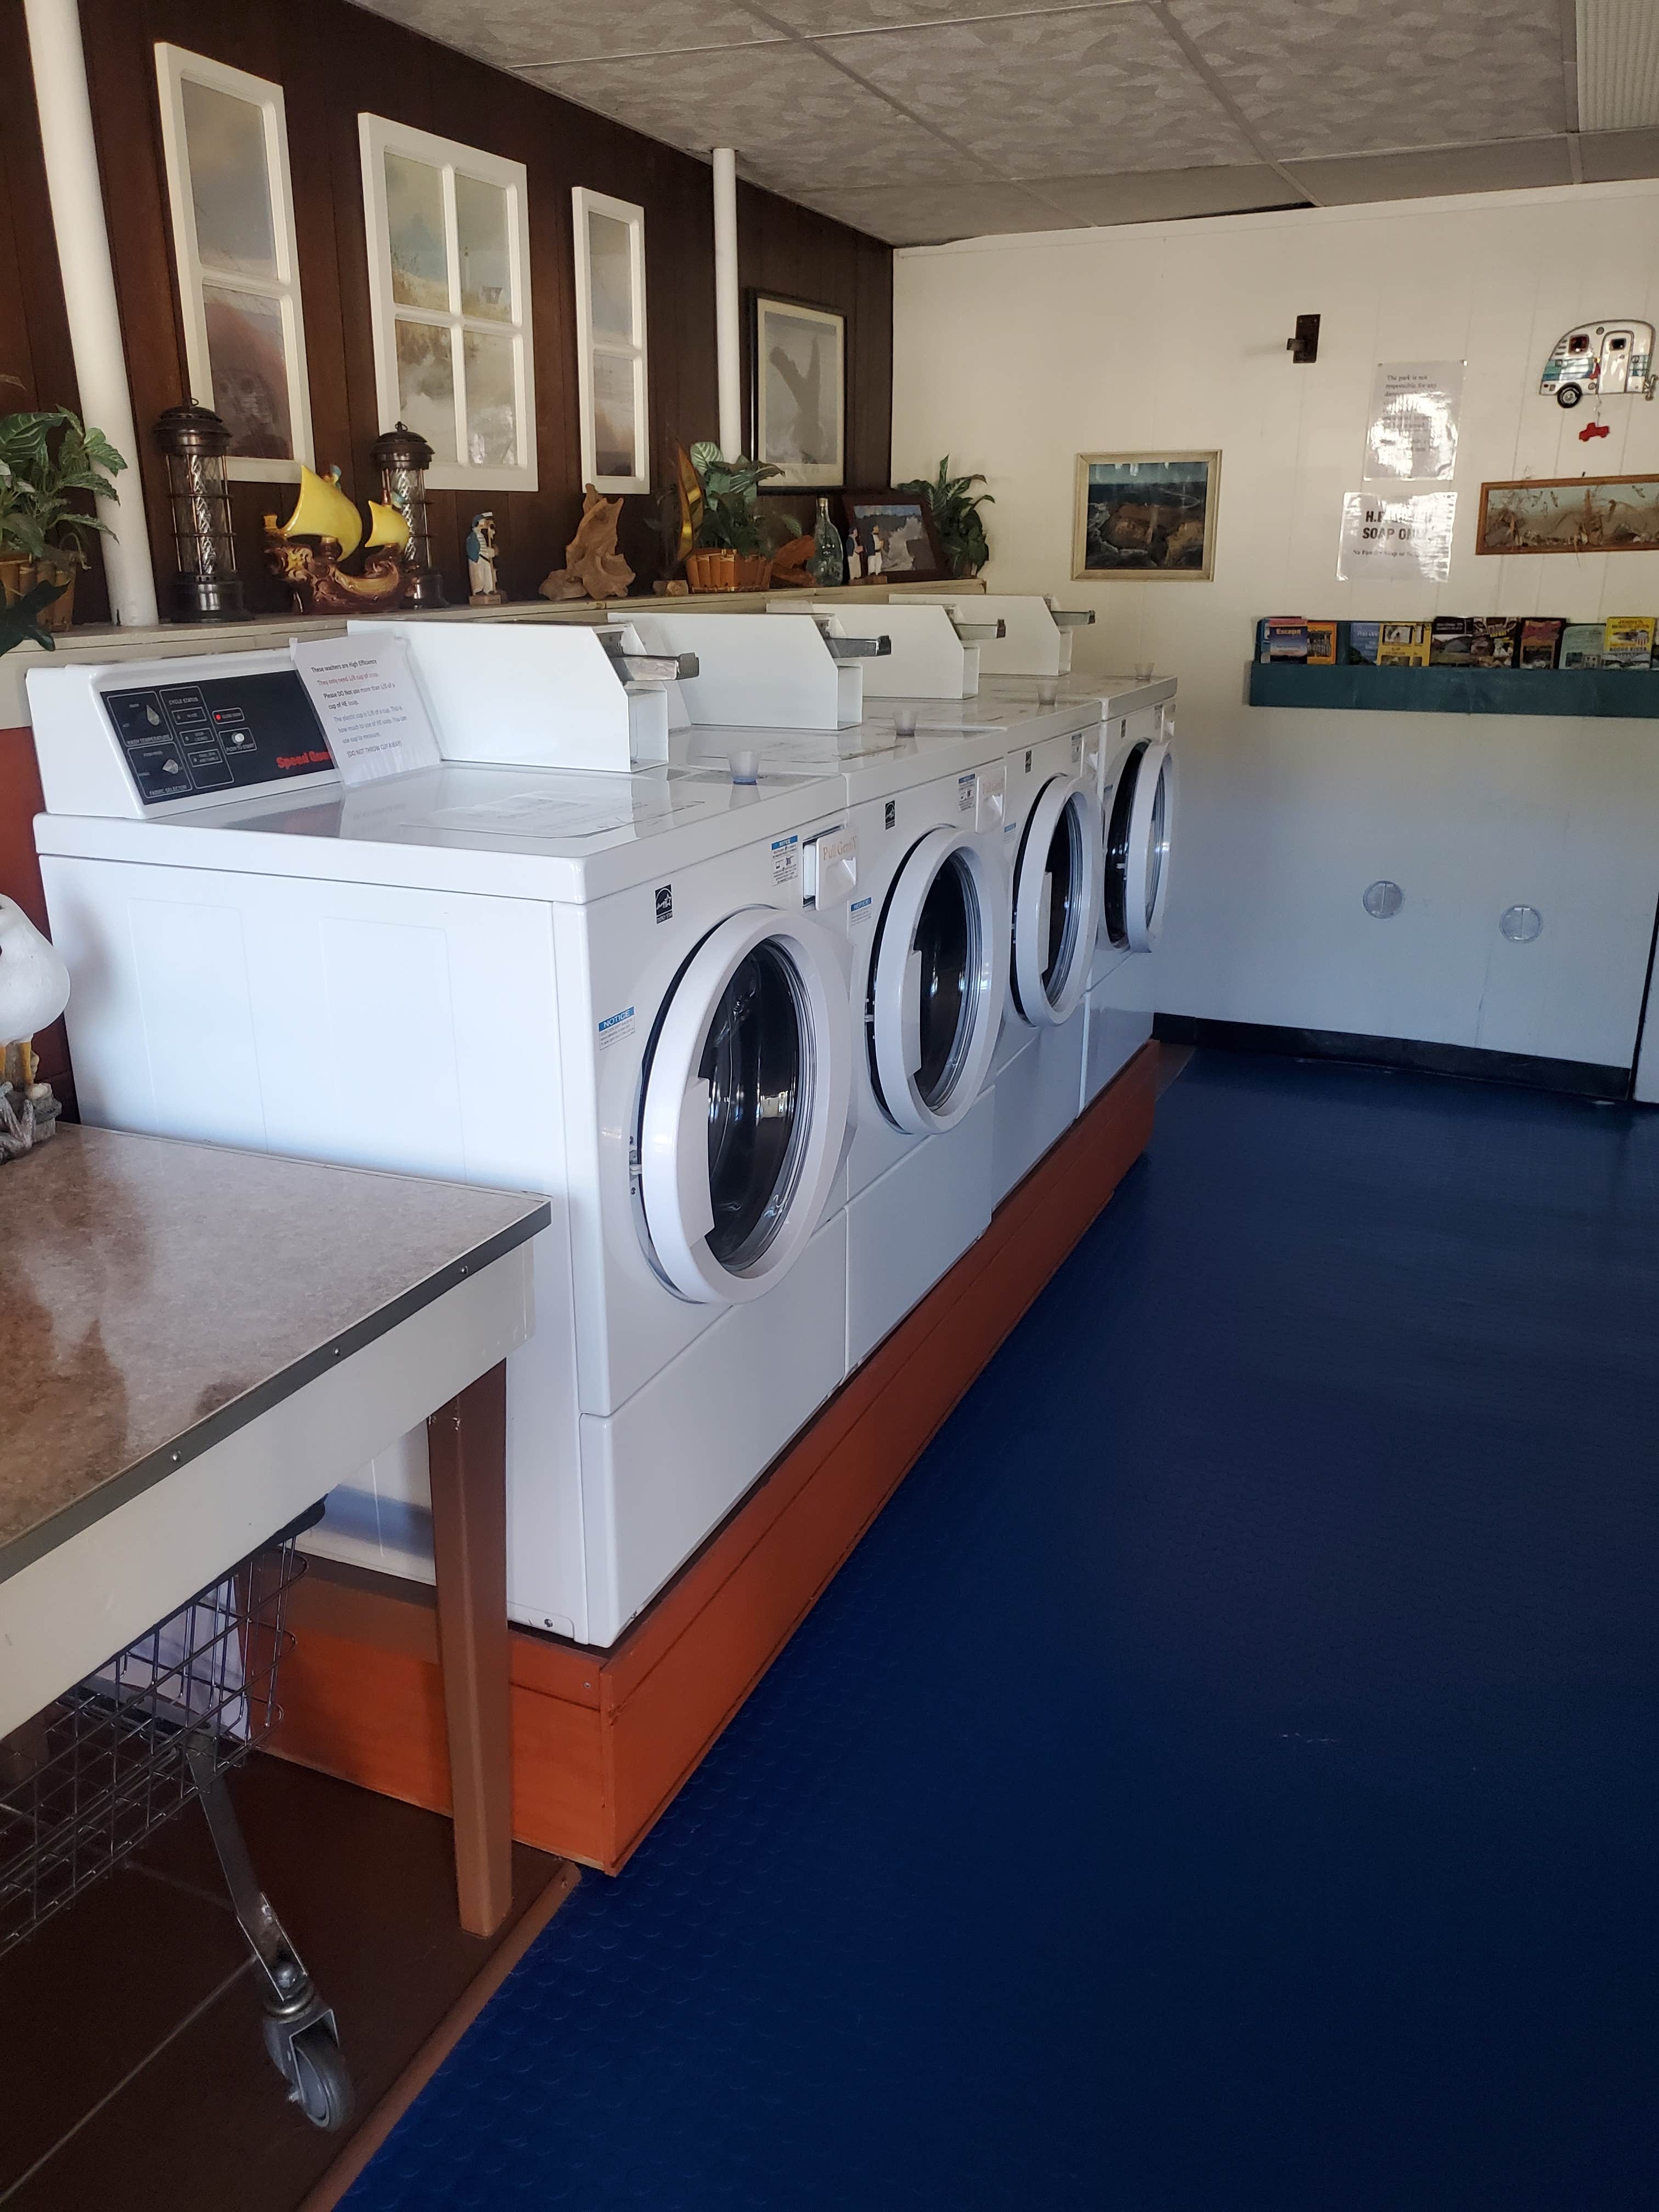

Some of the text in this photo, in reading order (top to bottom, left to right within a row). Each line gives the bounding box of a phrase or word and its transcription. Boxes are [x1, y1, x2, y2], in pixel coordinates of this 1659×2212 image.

[1362, 527, 1395, 540] SOAP
[356, 747, 365, 755] NOT
[365, 745, 380, 754] THROW
[276, 752, 310, 769] Speed
[823, 843, 837, 861] Pull
[603, 1010, 630, 1029] NOTICE
